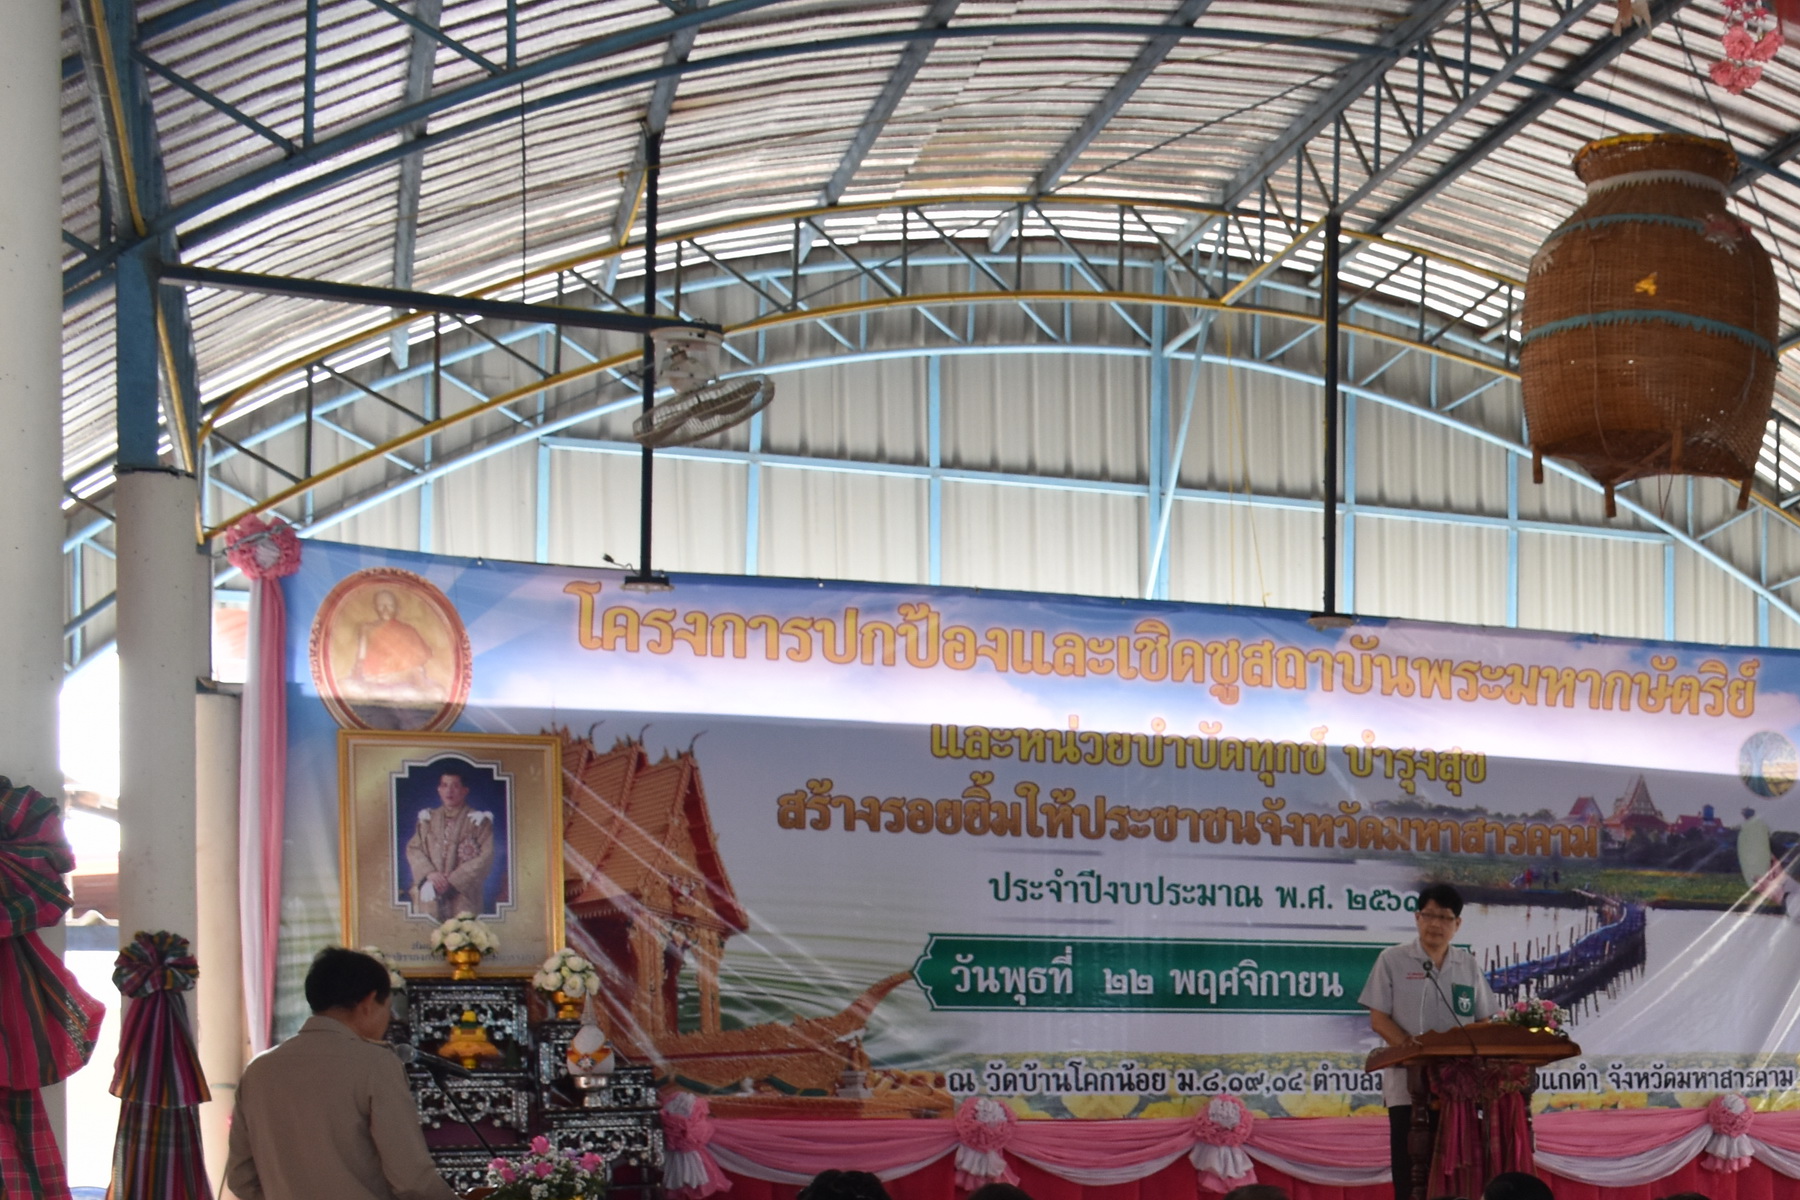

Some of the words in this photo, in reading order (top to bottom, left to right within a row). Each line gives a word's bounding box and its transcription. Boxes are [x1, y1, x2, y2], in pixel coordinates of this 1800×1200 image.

[563, 580, 1761, 718] โครงการปกป้องและเชิดชูสถาบันพระมหากษัตริย์
[1344, 729, 1487, 796] บำรุงสุข
[988, 868, 1263, 909] ประจำปีงบประมาณ
[1275, 884, 1333, 910] พ.ศ.
[950, 945, 1074, 1006] วันพุธที่
[1102, 967, 1154, 996] ๒๒
[1169, 960, 1344, 1004] พฤศจิกายน
[949, 1071, 976, 1092] ณ
[987, 1061, 1166, 1092] วัดบ้านโคกน้อย
[1608, 1063, 1793, 1090] จังหวัดมหาสารคาม
